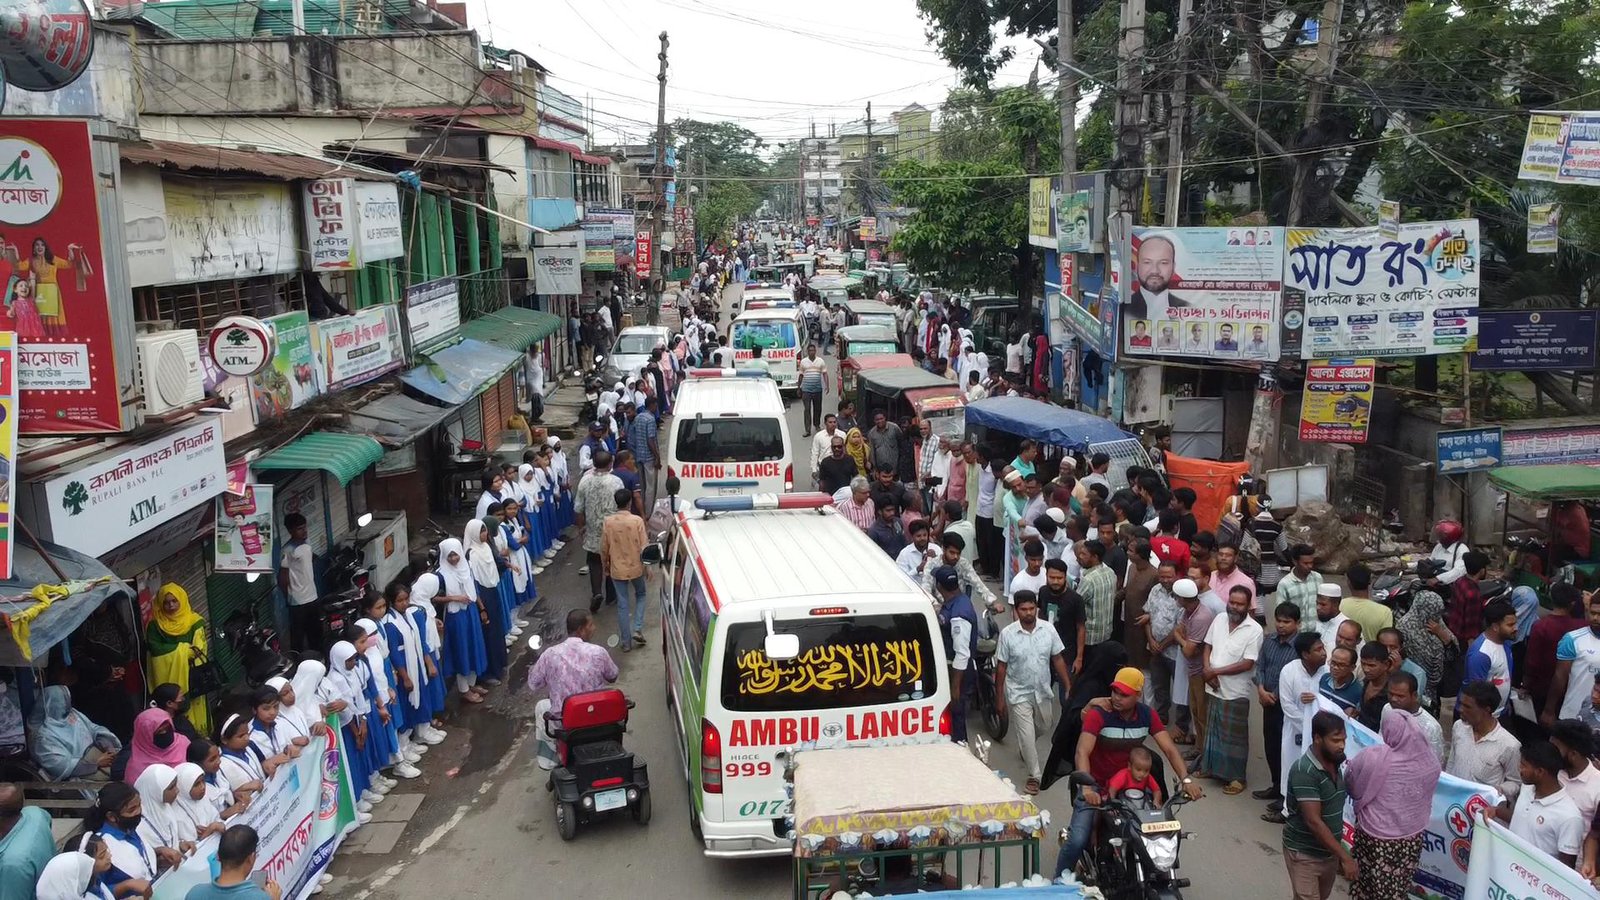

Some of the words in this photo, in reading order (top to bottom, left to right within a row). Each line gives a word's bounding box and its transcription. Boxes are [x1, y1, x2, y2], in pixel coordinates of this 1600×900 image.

[0, 187, 49, 205] মোজা
[1290, 240, 1372, 290] সাত
[1380, 238, 1428, 288] রং
[1307, 292, 1352, 306] পাবলিক
[1356, 293, 1377, 306] স্কুল
[1380, 292, 1390, 302] ও
[1395, 287, 1433, 302] কোচিং
[1438, 284, 1479, 299] সেন্টার
[1166, 307, 1205, 321] শুভেচ্ছা
[1209, 308, 1217, 318] ও
[1221, 303, 1270, 320] অভিনন্দন
[223, 356, 248, 365] ATM
[768, 349, 795, 358] LANCE
[88, 457, 134, 492] রূপালী
[135, 447, 172, 471] ব্যাংক
[174, 426, 214, 456] পিএলসি
[736, 463, 780, 477] LANCE
[91, 484, 123, 506] RUPALI
[127, 475, 147, 491] BANK
[128, 494, 158, 527] ATM
[729, 717, 819, 747] AMBU
[846, 706, 934, 740] LANCE
[725, 762, 772, 777] 999
[1510, 863, 1540, 888] শেরপুর
